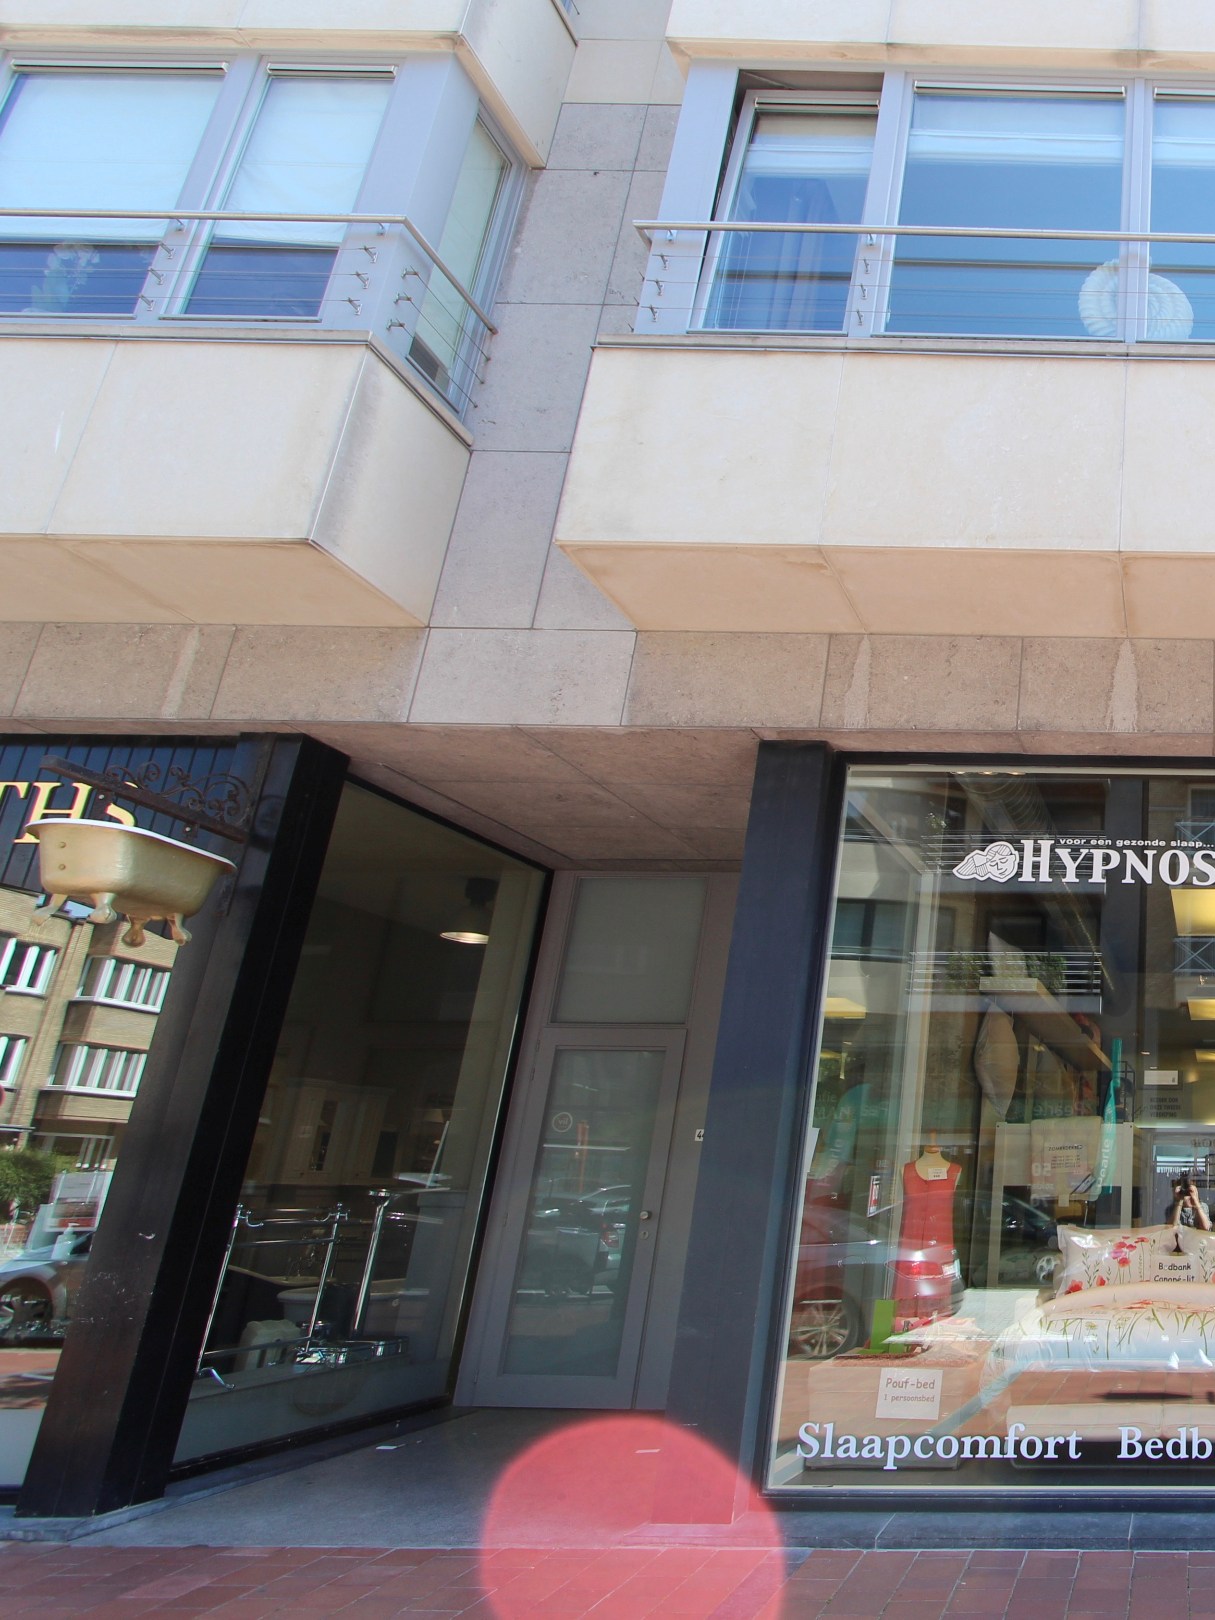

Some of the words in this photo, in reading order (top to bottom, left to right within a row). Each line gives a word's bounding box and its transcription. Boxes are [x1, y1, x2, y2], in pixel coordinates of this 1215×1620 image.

[1059, 838, 1087, 846] voor
[1115, 839, 1166, 848] gezonde
[885, 1378, 936, 1390] Pouf-bed
[891, 1395, 935, 1403] persoonsbed
[796, 1422, 1082, 1470] Slaapcomfort
